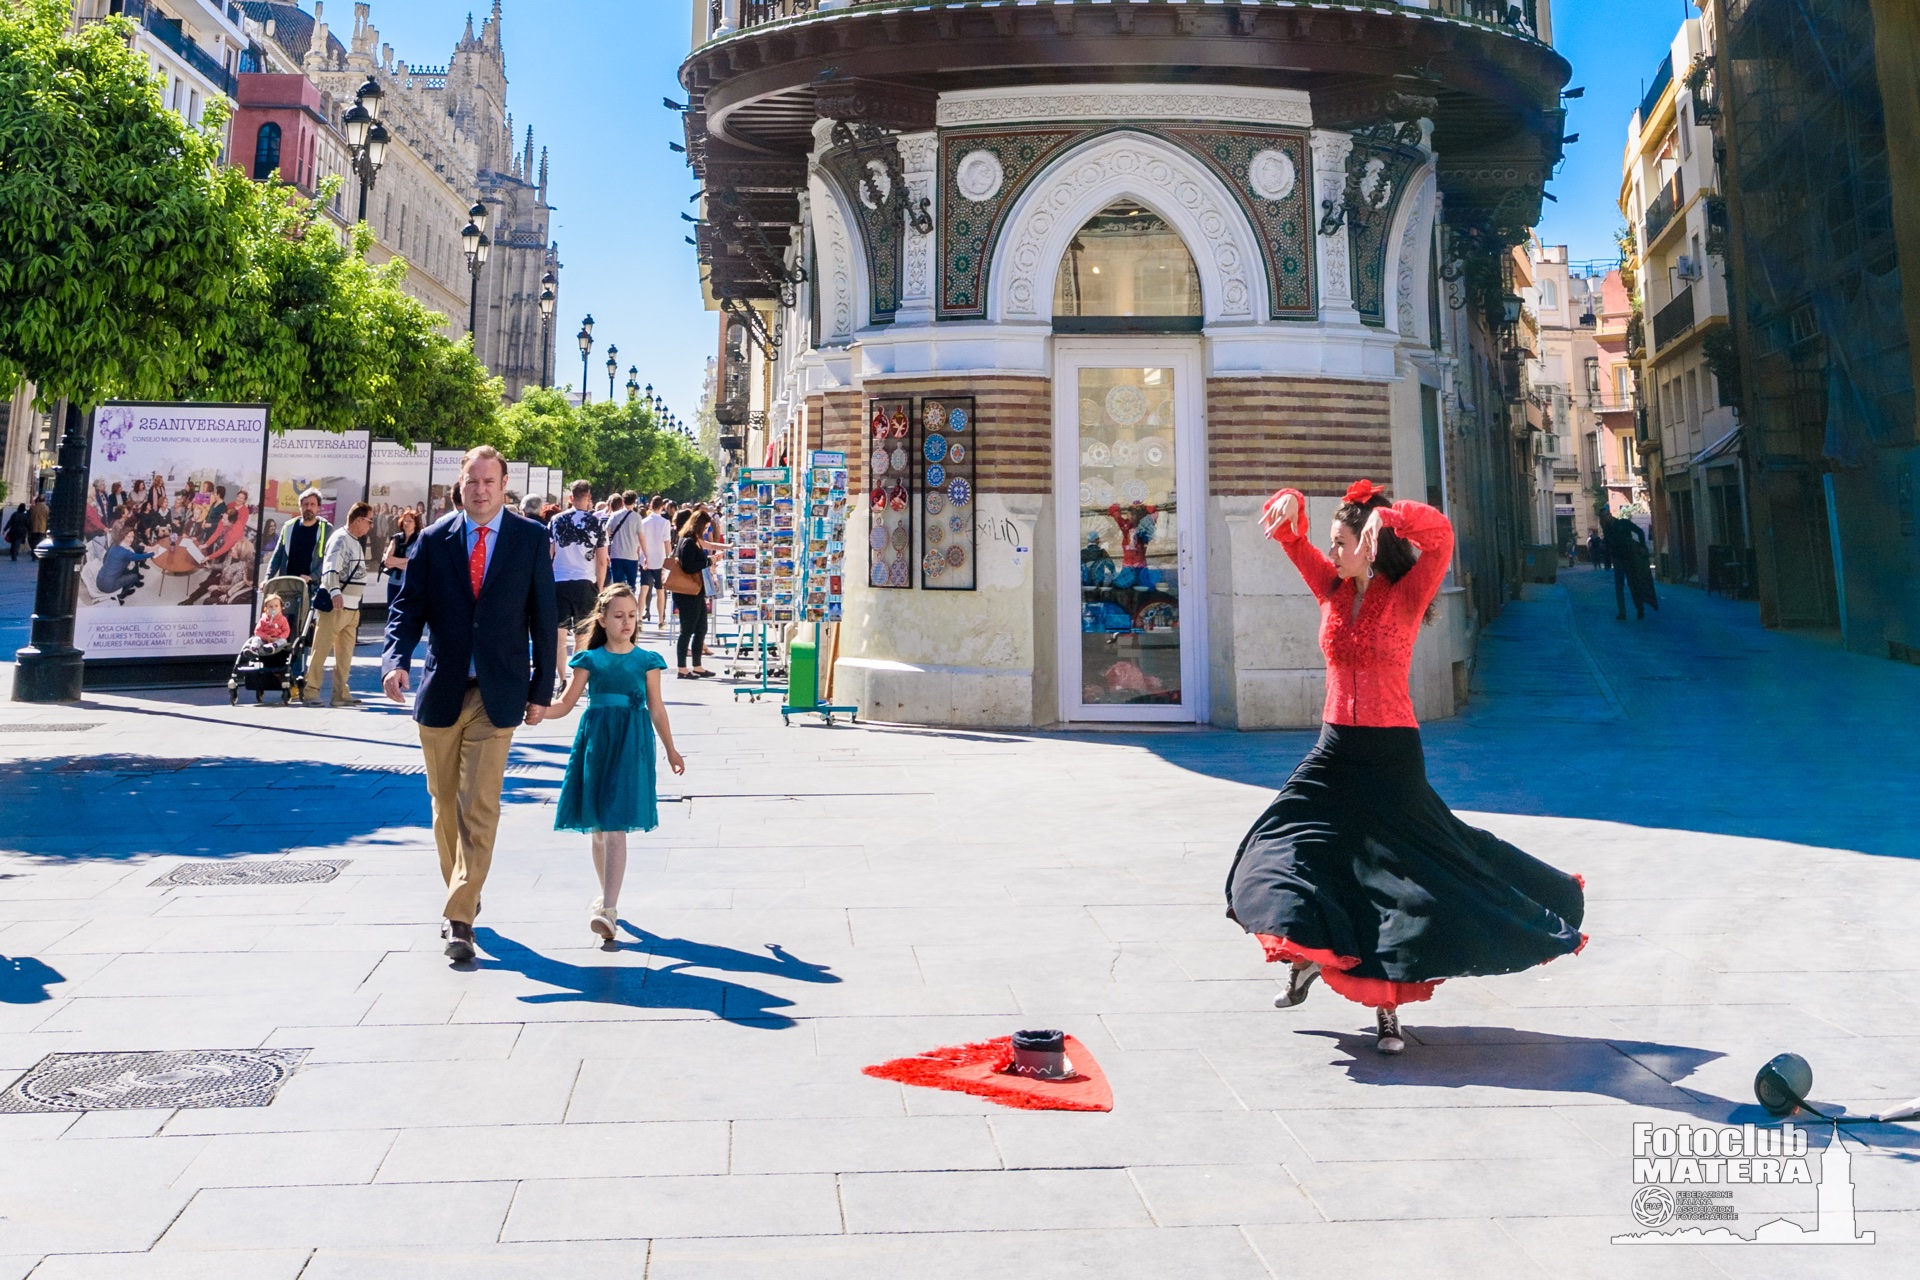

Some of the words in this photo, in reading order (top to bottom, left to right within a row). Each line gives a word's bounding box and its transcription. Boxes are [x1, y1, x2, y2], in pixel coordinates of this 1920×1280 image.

[139, 417, 262, 432] 25ANIVERSARIO
[272, 438, 367, 450] 25ANIVERSARIO
[371, 449, 429, 458] NIVERSARIO
